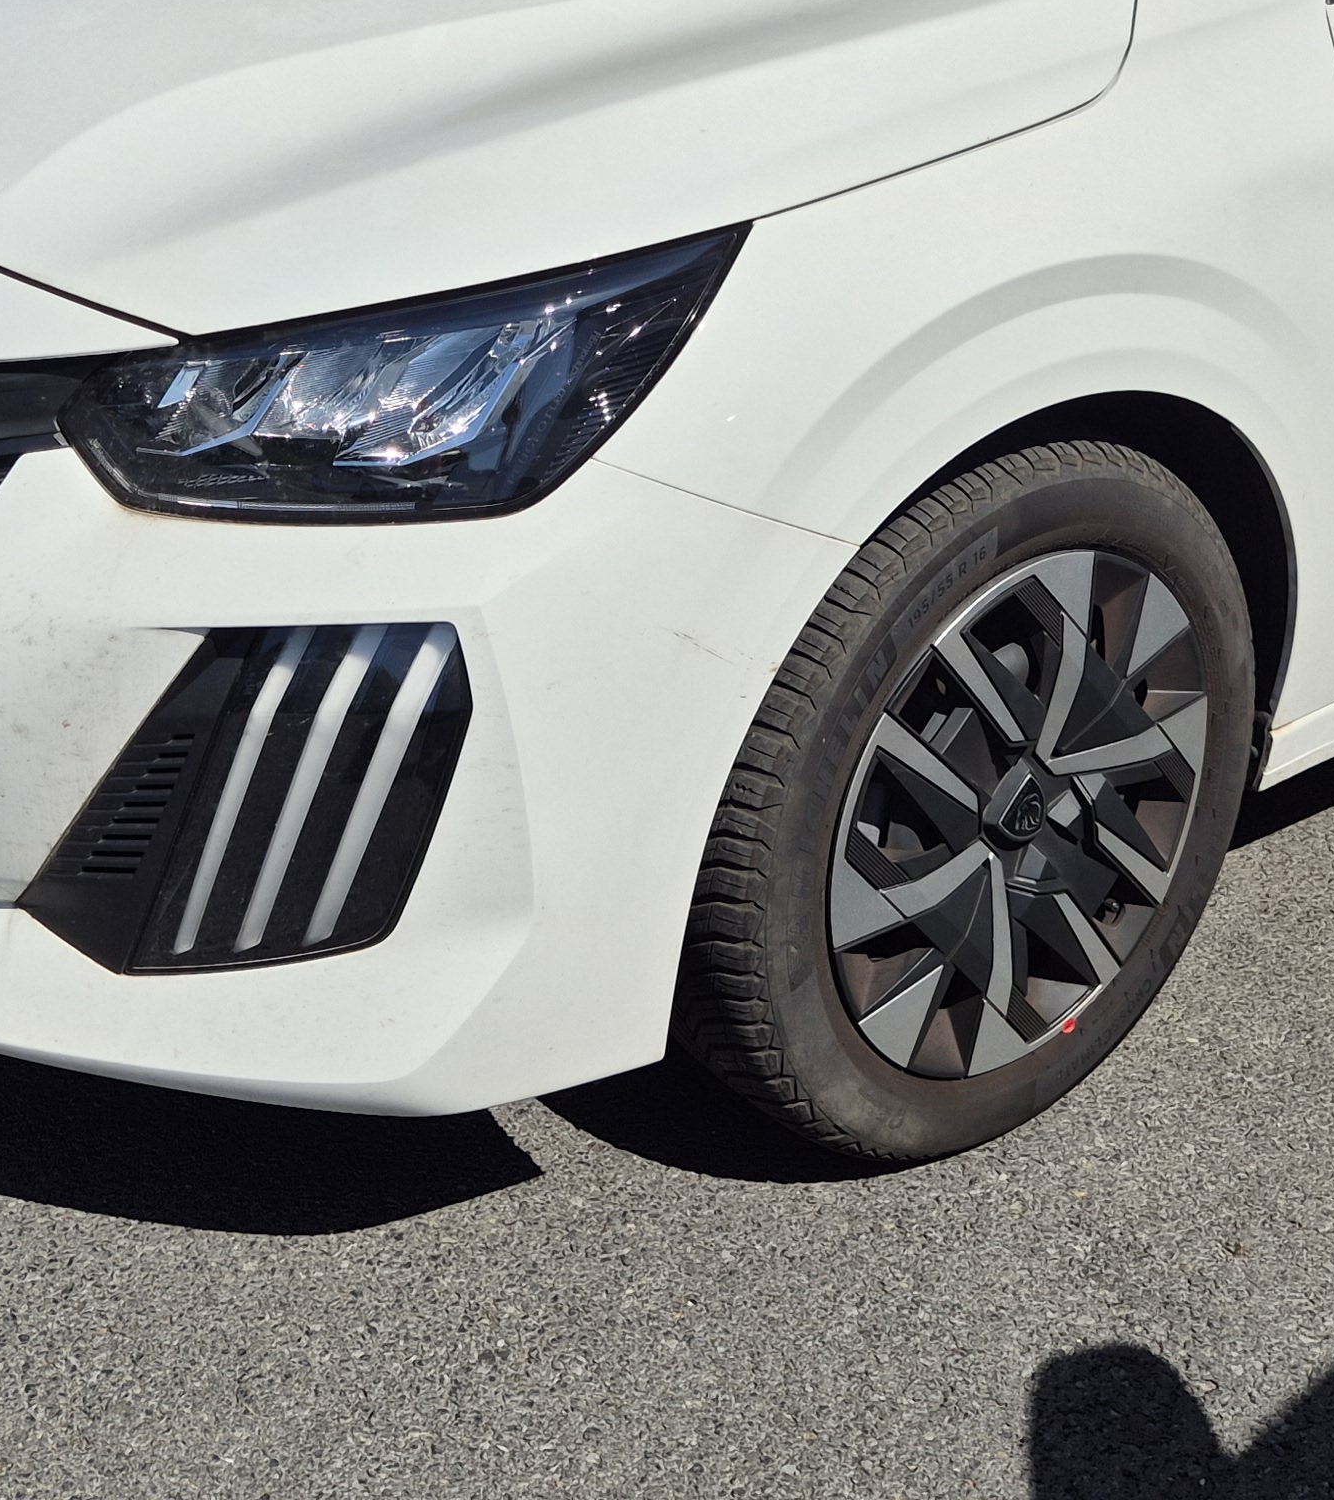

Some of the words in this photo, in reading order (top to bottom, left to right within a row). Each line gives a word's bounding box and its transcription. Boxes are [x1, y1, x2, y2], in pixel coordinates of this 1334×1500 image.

[908, 574, 954, 629] 195/55
[958, 561, 967, 578] R
[972, 545, 987, 566] 16
